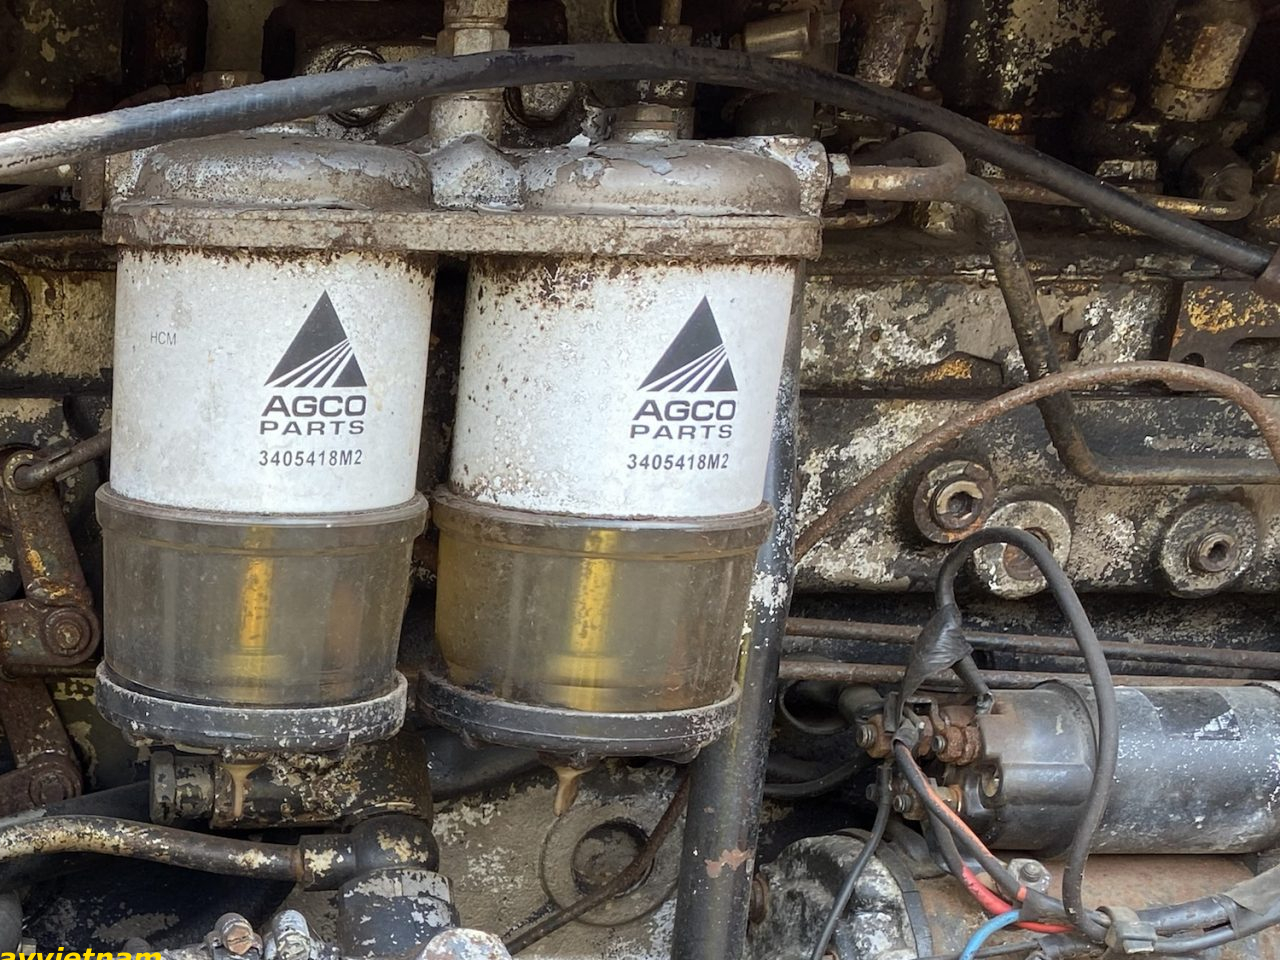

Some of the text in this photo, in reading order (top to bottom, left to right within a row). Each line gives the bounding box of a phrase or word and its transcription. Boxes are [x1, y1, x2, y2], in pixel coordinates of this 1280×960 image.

[150, 331, 177, 345] HCM
[261, 395, 367, 417] AGCO
[632, 399, 737, 421] AGCO
[259, 420, 365, 436] PARTS
[630, 424, 733, 439] PARTS
[258, 449, 363, 466] 3405418M2
[626, 453, 729, 470] 3405418M2
